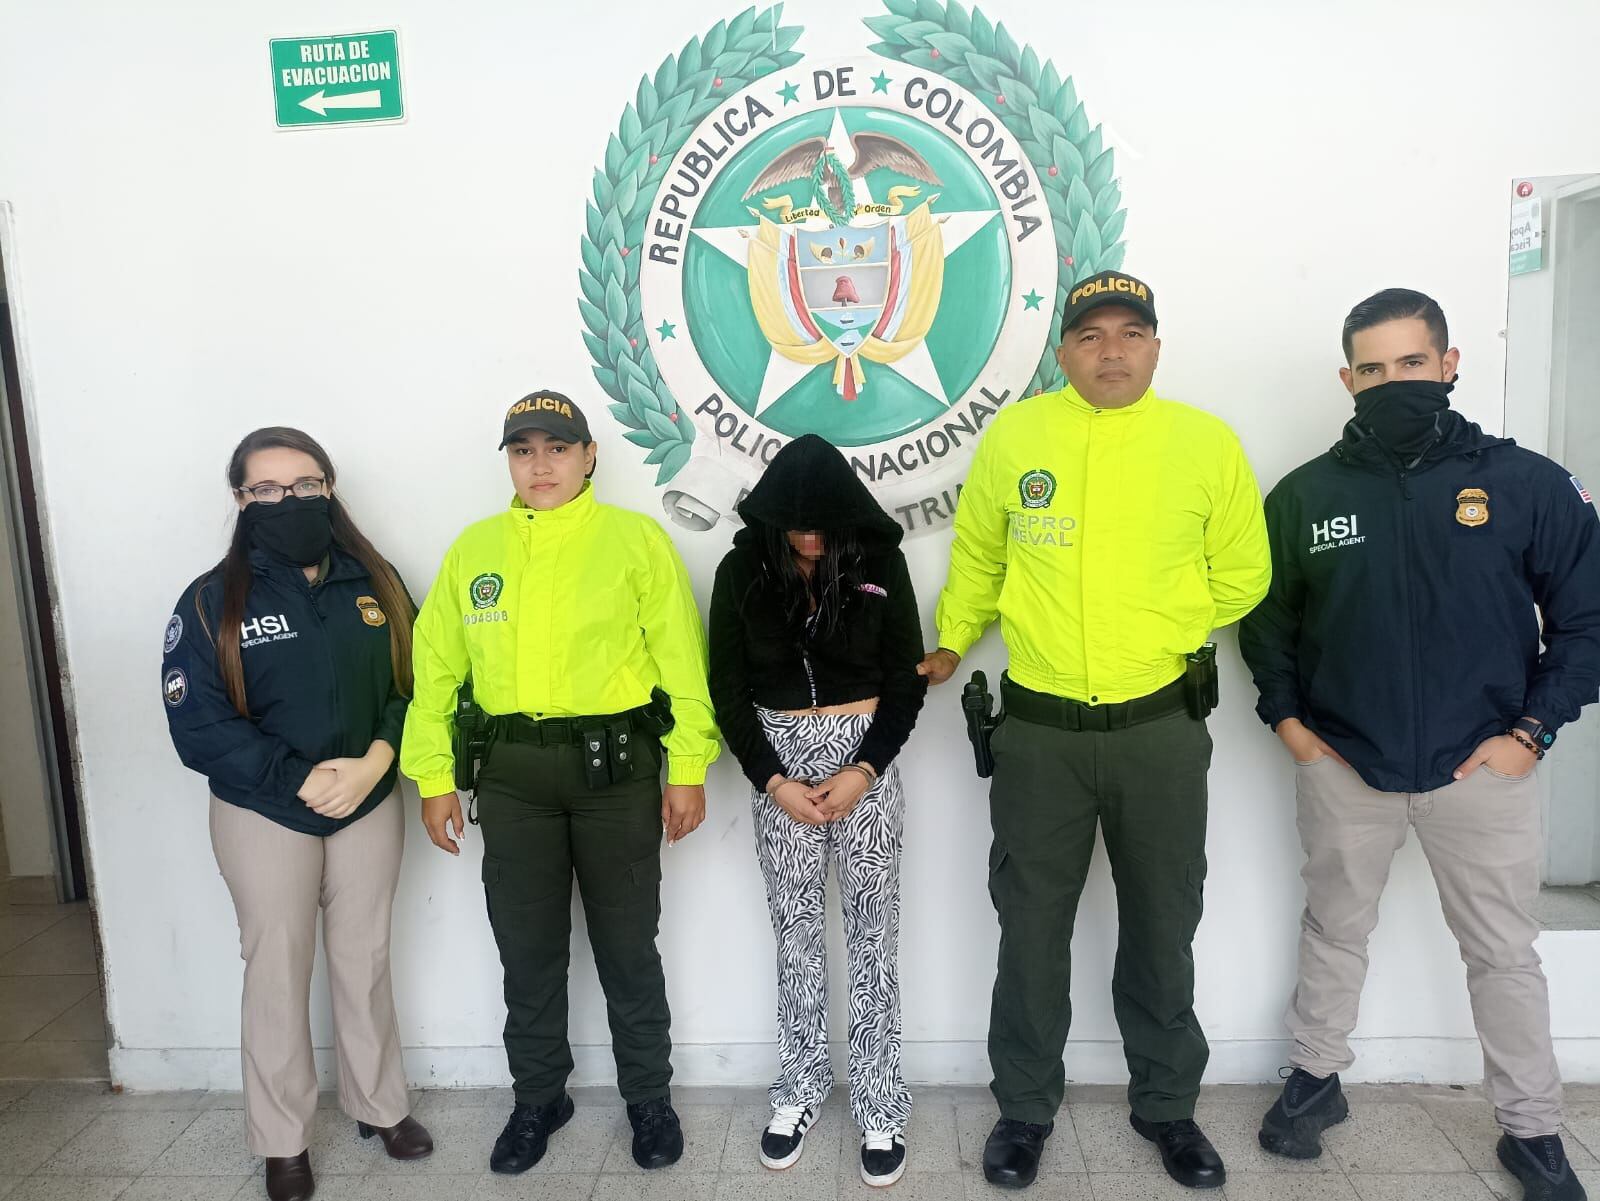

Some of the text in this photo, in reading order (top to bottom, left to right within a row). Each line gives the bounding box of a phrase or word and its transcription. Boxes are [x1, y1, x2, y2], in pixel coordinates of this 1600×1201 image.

[300, 40, 371, 63] RUTA DE
[282, 61, 392, 87] EVACUACION
[648, 66, 1043, 266] REPUBLICA DE COLOMBIA
[785, 208, 821, 223] Libertad
[864, 204, 892, 214] Orden
[1071, 277, 1148, 305] POLICIA
[507, 397, 573, 420] POLICIA
[694, 386, 1012, 482] POLIC NACIONAL
[894, 483, 964, 531] TRI
[1311, 514, 1358, 545] HSI
[1309, 535, 1366, 554] SPECIAL AGENT
[240, 614, 290, 640] HSI
[240, 631, 299, 649] SPECIAL AGENT
